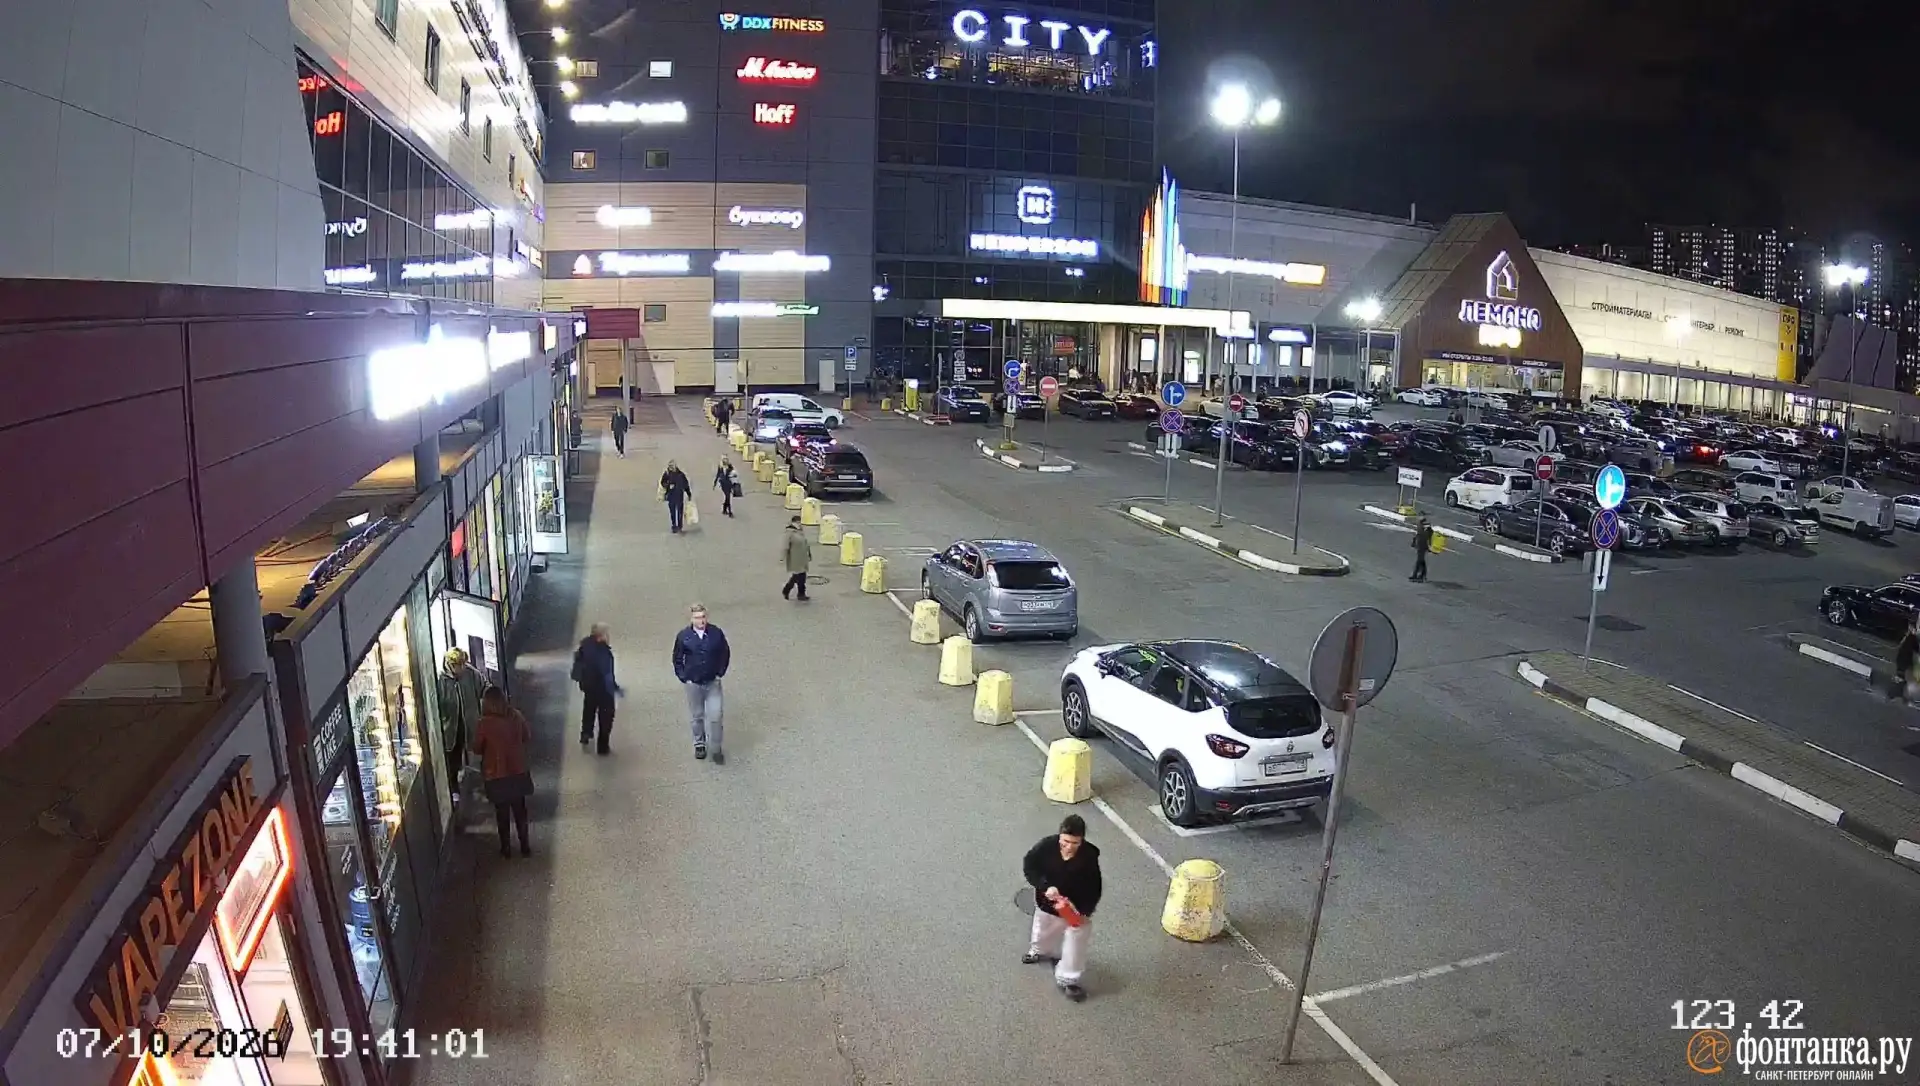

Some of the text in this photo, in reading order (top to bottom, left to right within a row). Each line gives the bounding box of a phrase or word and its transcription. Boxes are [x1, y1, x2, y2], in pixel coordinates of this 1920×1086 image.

[952, 9, 1112, 56] CITY
[755, 102, 796, 124] Hoff
[1591, 302, 1653, 320] СТРОЙМАТЕРИАЛЫ
[320, 703, 342, 744] COFFEE
[323, 733, 338, 765] LIKE
